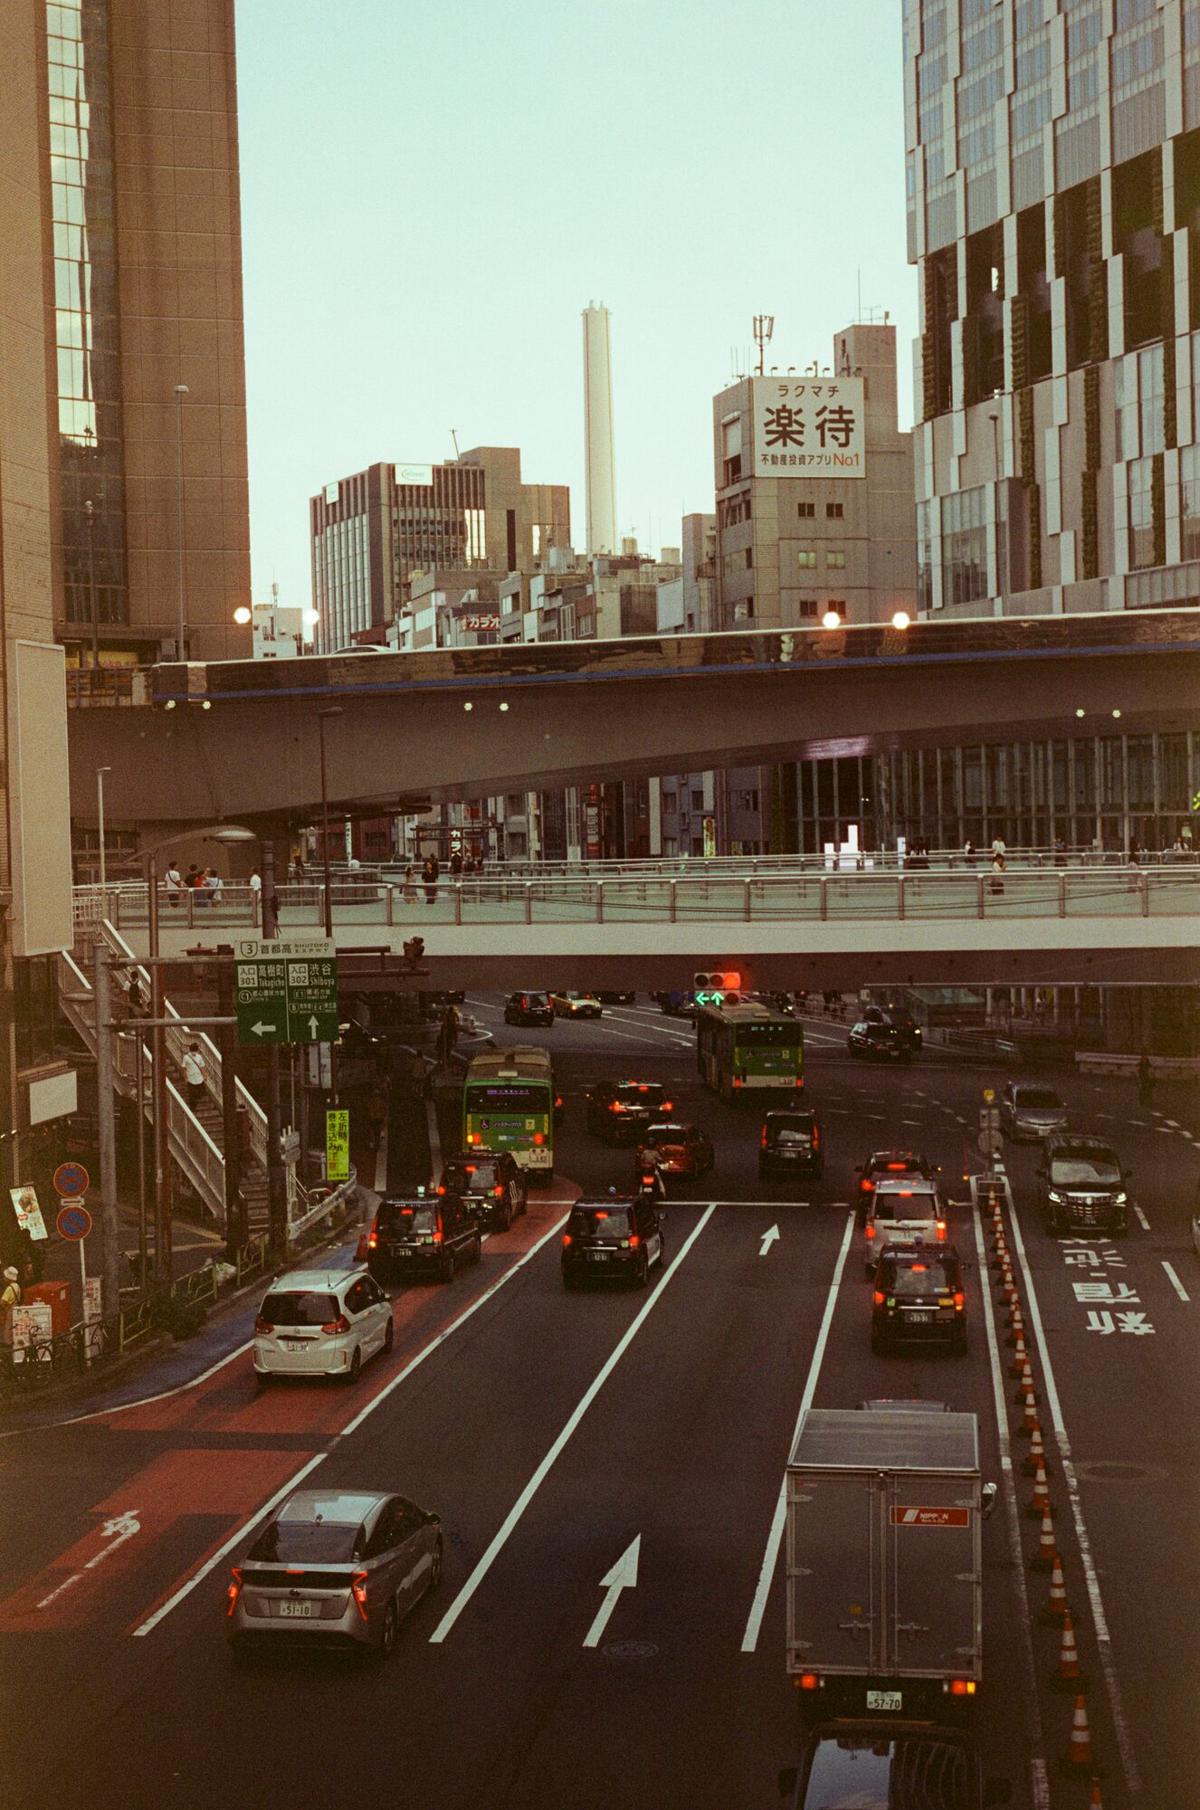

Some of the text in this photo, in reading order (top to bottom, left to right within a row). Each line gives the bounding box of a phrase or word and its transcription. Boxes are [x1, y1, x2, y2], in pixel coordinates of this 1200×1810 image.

[777, 385, 839, 398] ラクマチ
[763, 404, 855, 448] 楽待
[261, 943, 292, 954] 首都高
[240, 964, 284, 977] 入口 高樹町
[291, 963, 332, 976] 入口 渋谷
[240, 976, 256, 986] 301
[291, 975, 335, 987] 302 Shibuya
[874, 1698, 900, 1709] 57-70
